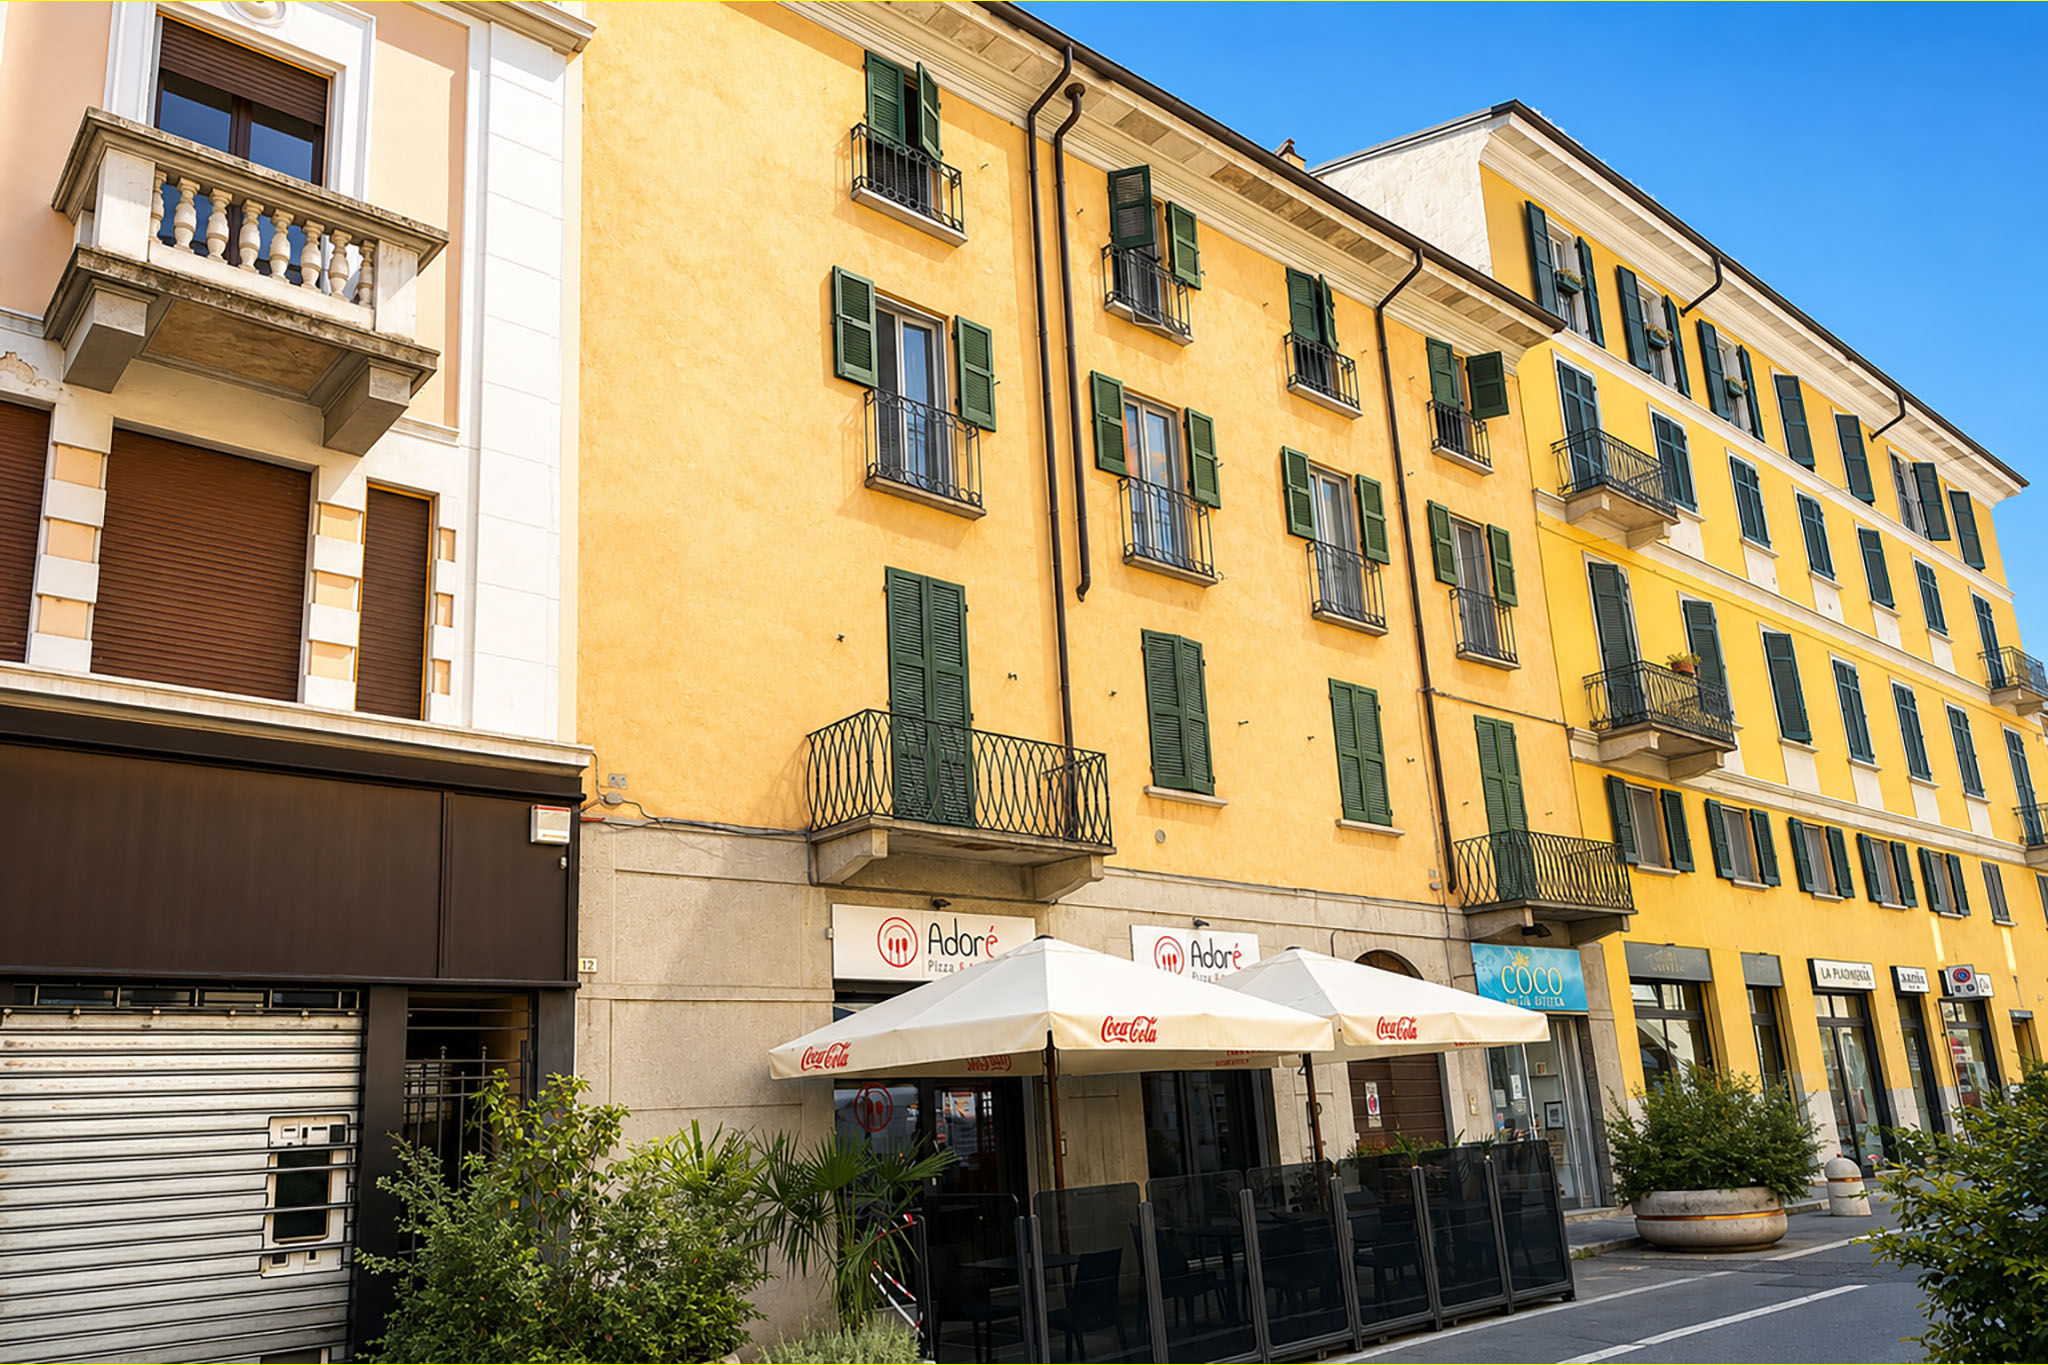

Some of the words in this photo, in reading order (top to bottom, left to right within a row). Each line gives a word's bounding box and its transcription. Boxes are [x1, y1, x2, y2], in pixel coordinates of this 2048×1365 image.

[928, 918, 998, 959] Adoré
[1191, 938, 1242, 970] Adoré
[582, 960, 594, 970] 12
[1501, 965, 1563, 995] COCO
